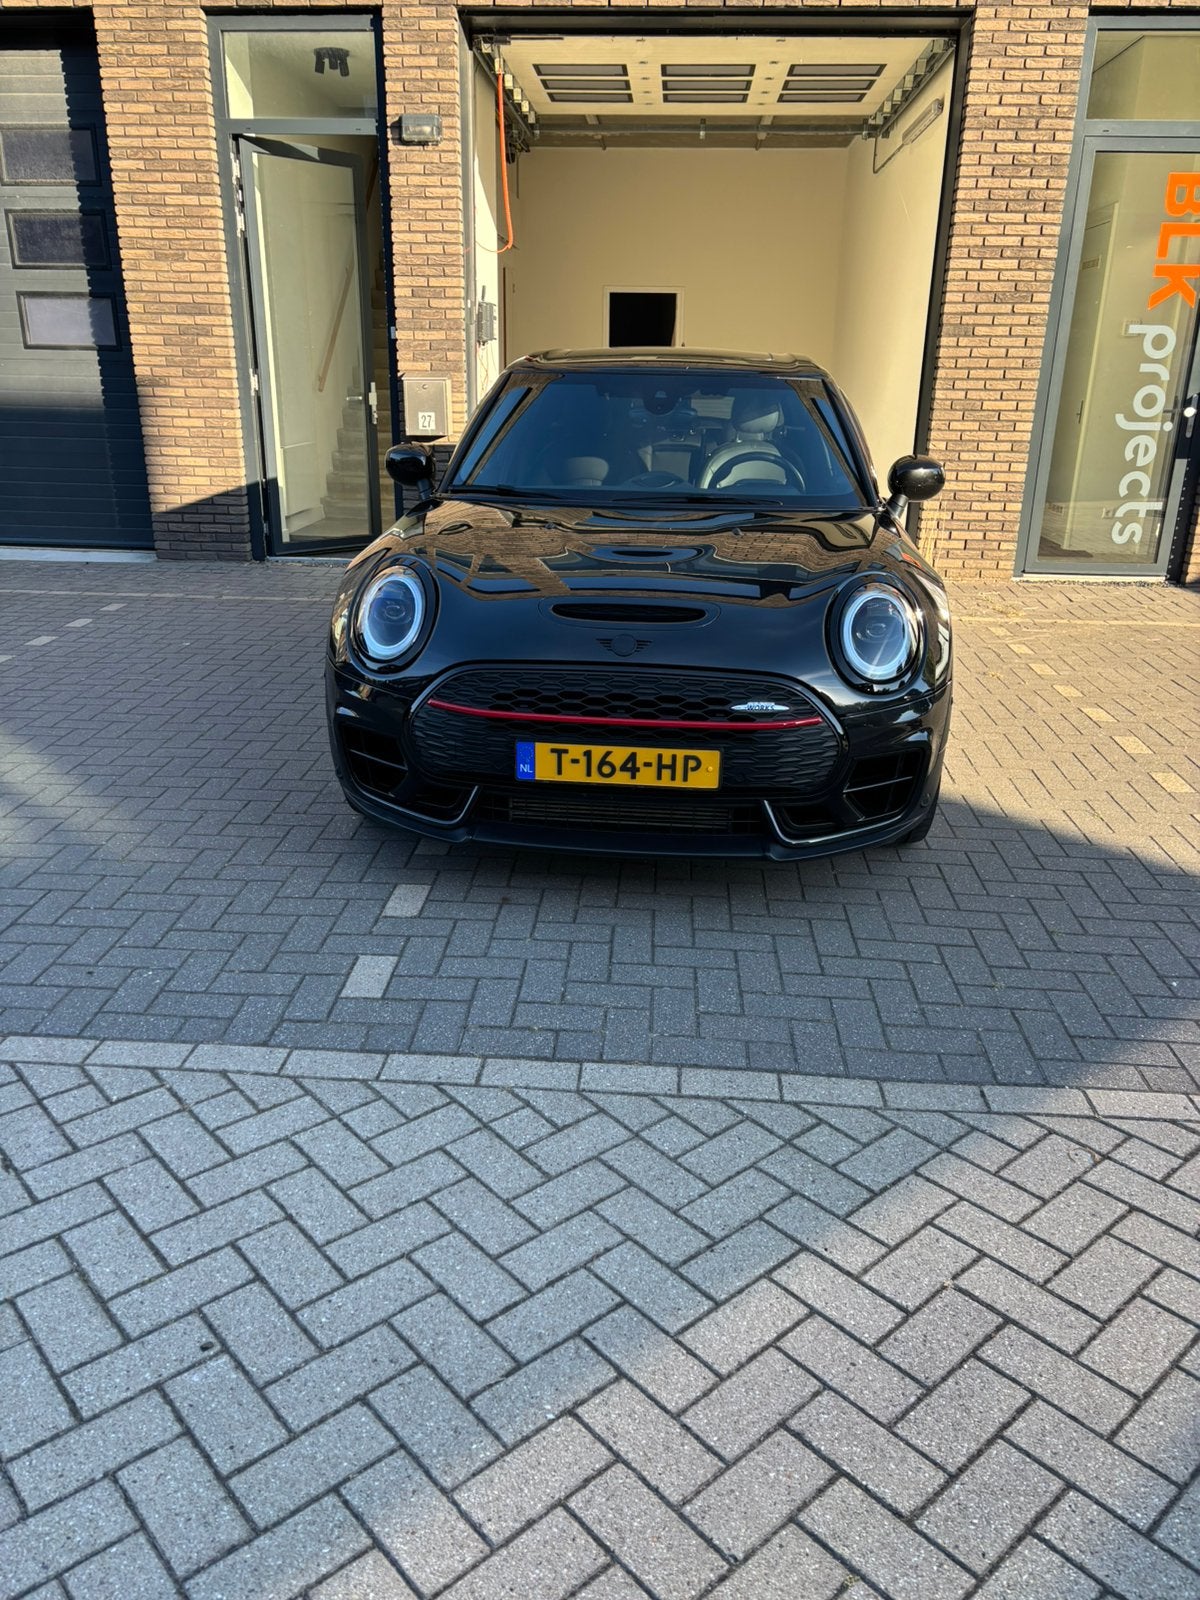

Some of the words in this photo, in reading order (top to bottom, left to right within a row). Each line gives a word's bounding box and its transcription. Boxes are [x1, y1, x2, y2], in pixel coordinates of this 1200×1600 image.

[1147, 171, 1200, 311] BLK
[421, 414, 432, 428] 27
[1111, 324, 1177, 545] projects
[520, 763, 533, 773] NL
[550, 748, 702, 782] T-164-HP
